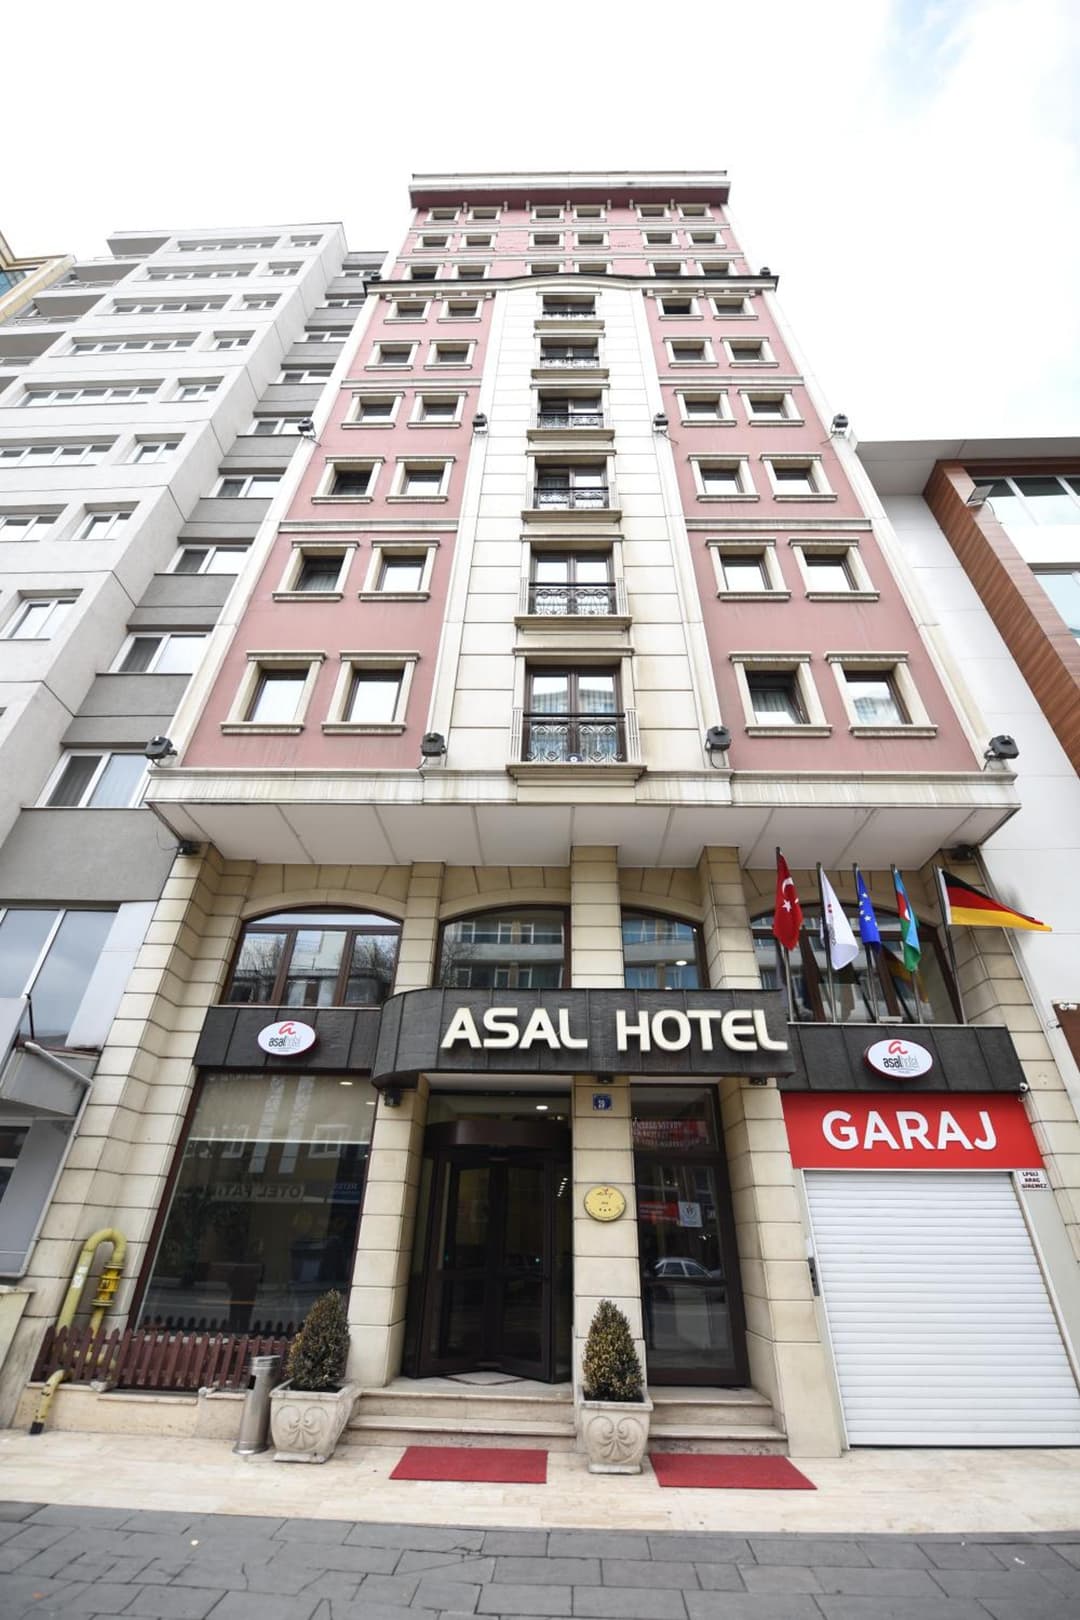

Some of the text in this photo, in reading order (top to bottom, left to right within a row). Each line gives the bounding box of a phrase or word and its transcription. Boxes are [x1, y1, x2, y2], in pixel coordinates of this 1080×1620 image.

[440, 1007, 788, 1051] ASAL HOTEL
[822, 1110, 997, 1150] GARAJ
